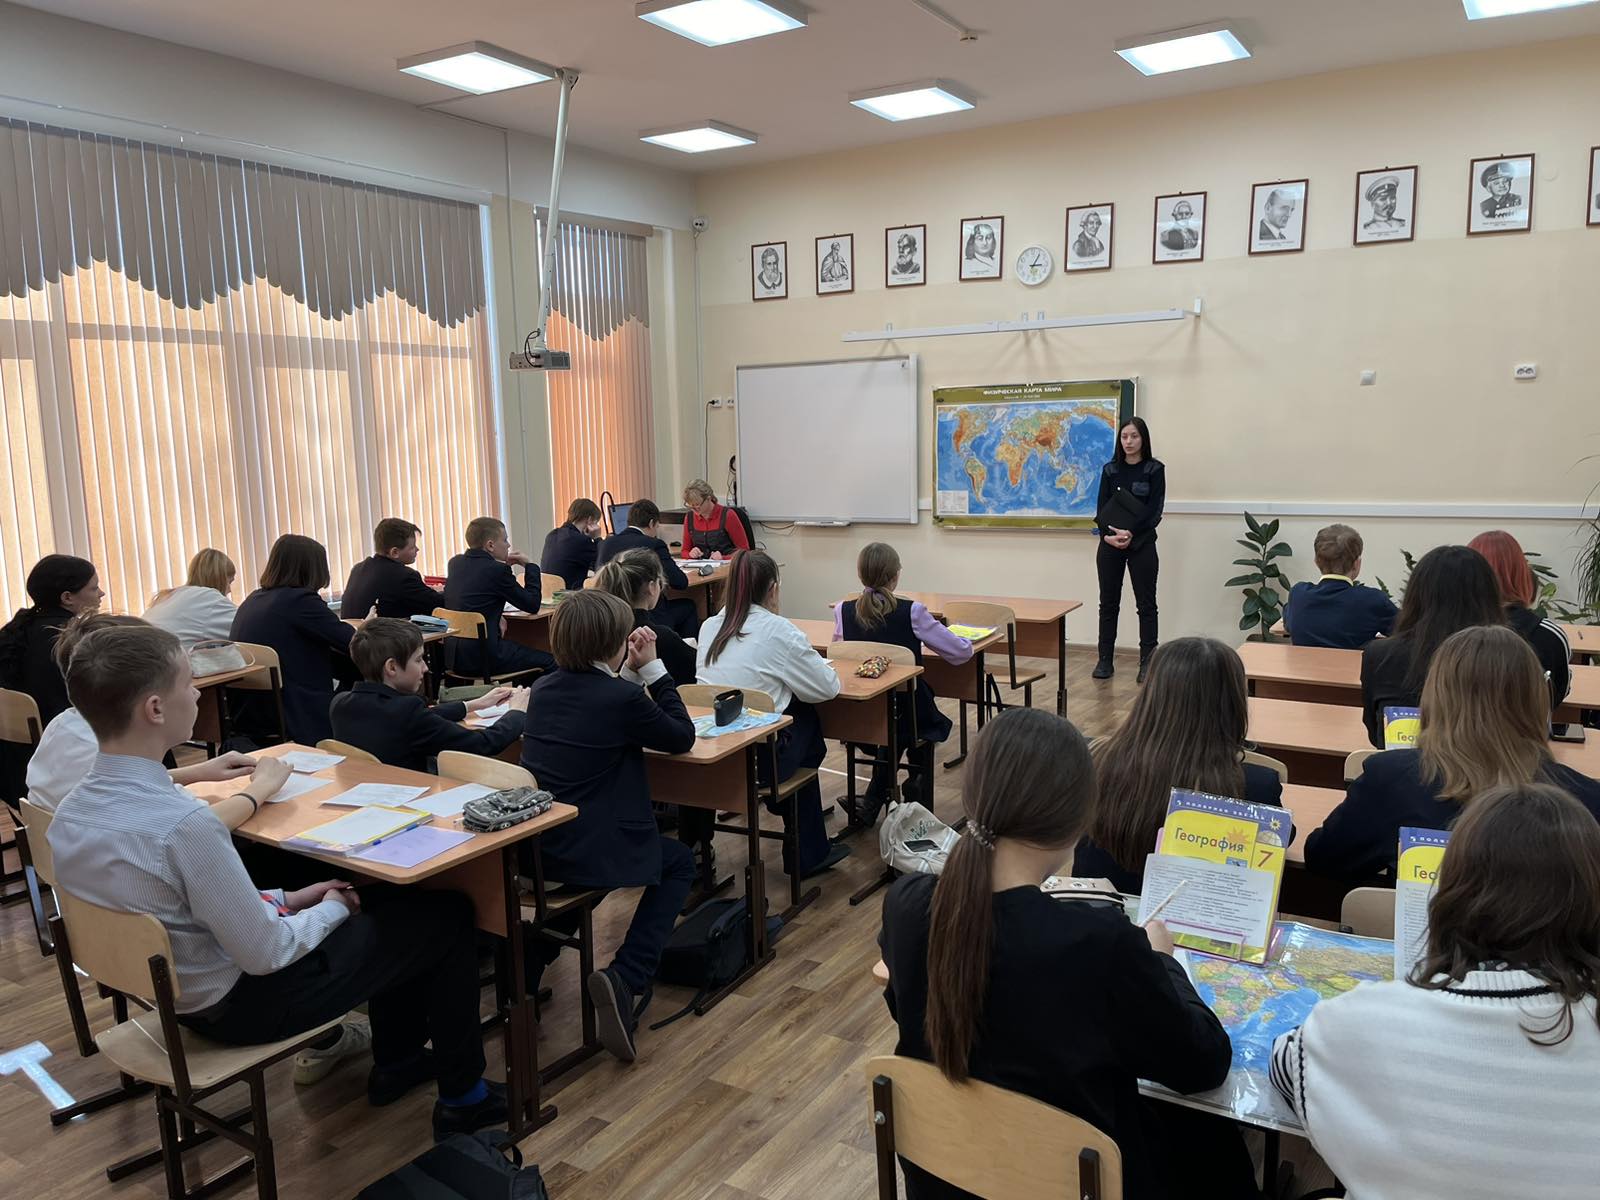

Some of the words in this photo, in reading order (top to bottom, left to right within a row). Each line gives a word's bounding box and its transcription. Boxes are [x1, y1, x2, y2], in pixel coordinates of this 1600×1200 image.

[1397, 731, 1415, 742] Гео
[1174, 827, 1245, 853] География
[1257, 850, 1274, 868] 7
[1414, 865, 1438, 880] Гео
